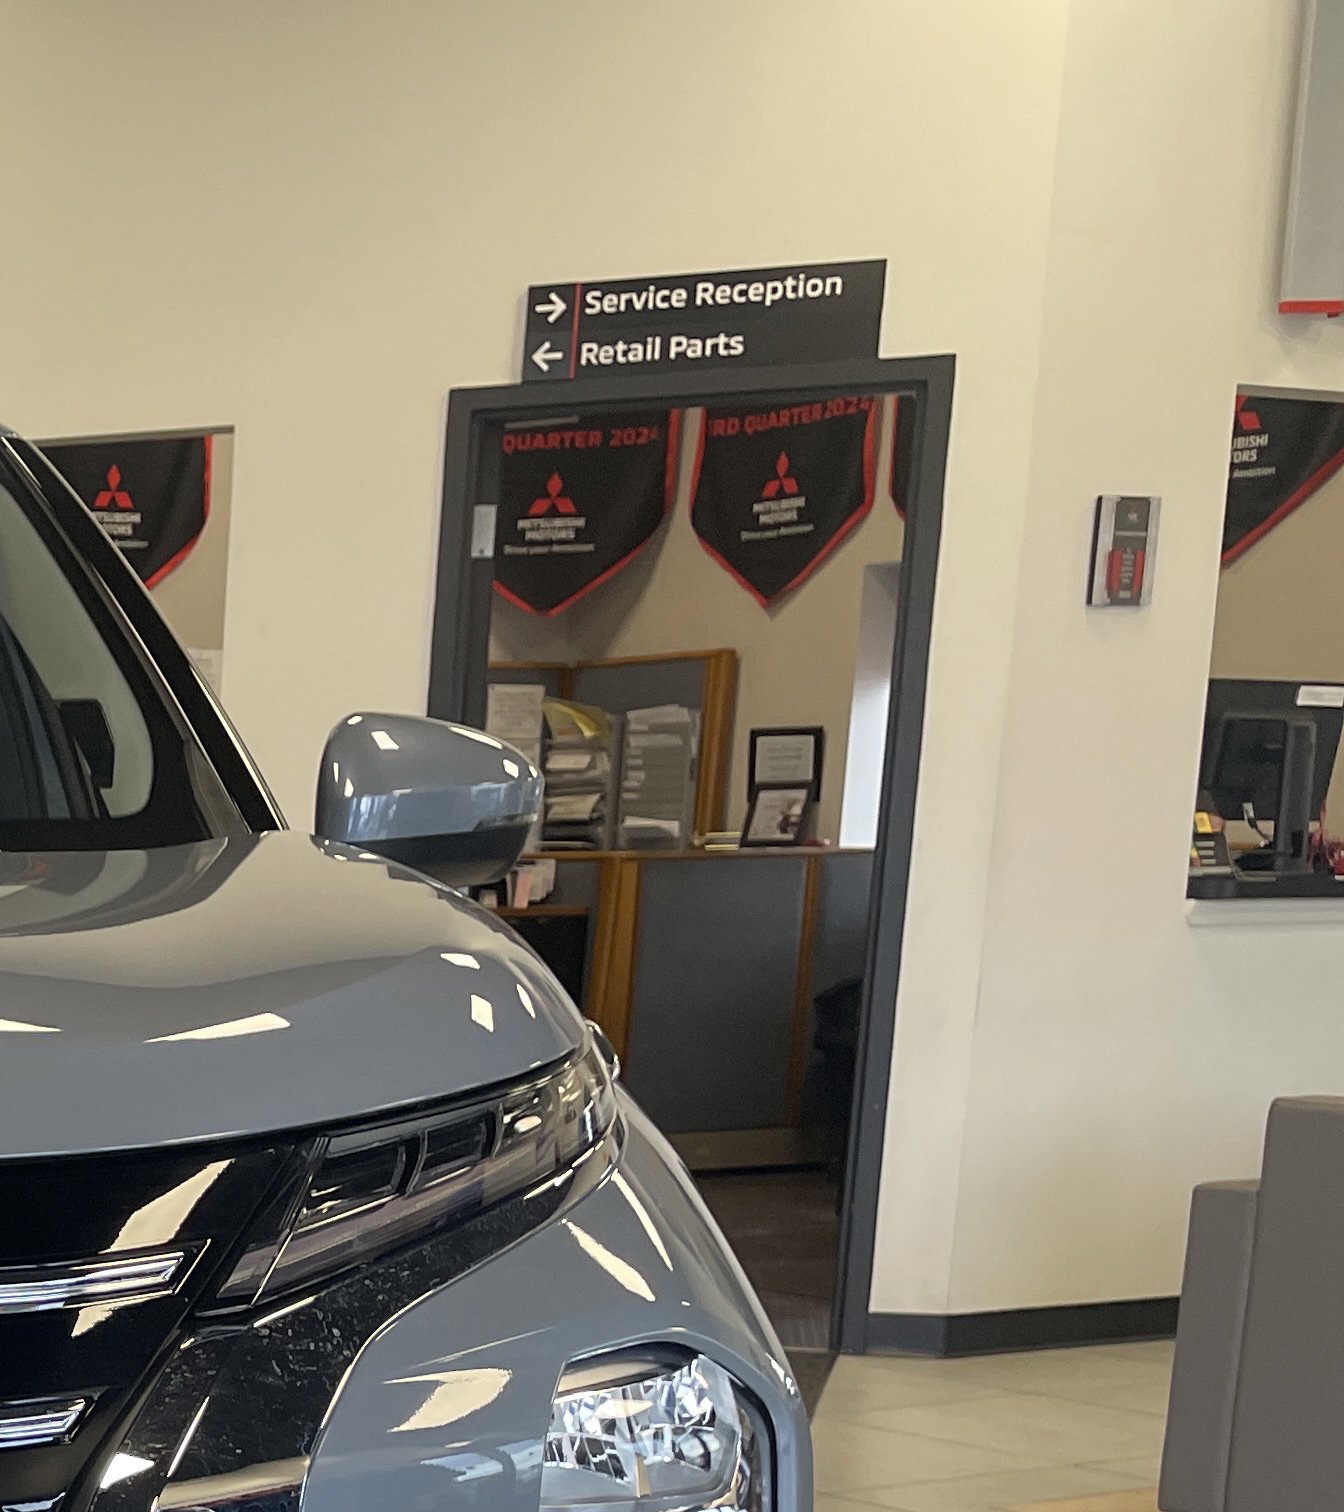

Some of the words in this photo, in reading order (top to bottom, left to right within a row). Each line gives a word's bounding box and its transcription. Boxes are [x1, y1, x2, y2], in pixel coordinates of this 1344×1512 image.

[583, 285, 688, 316] Service
[695, 272, 844, 307] Reception
[579, 336, 662, 367] Retail
[668, 332, 745, 361] Parts
[503, 430, 603, 454] QUARTER
